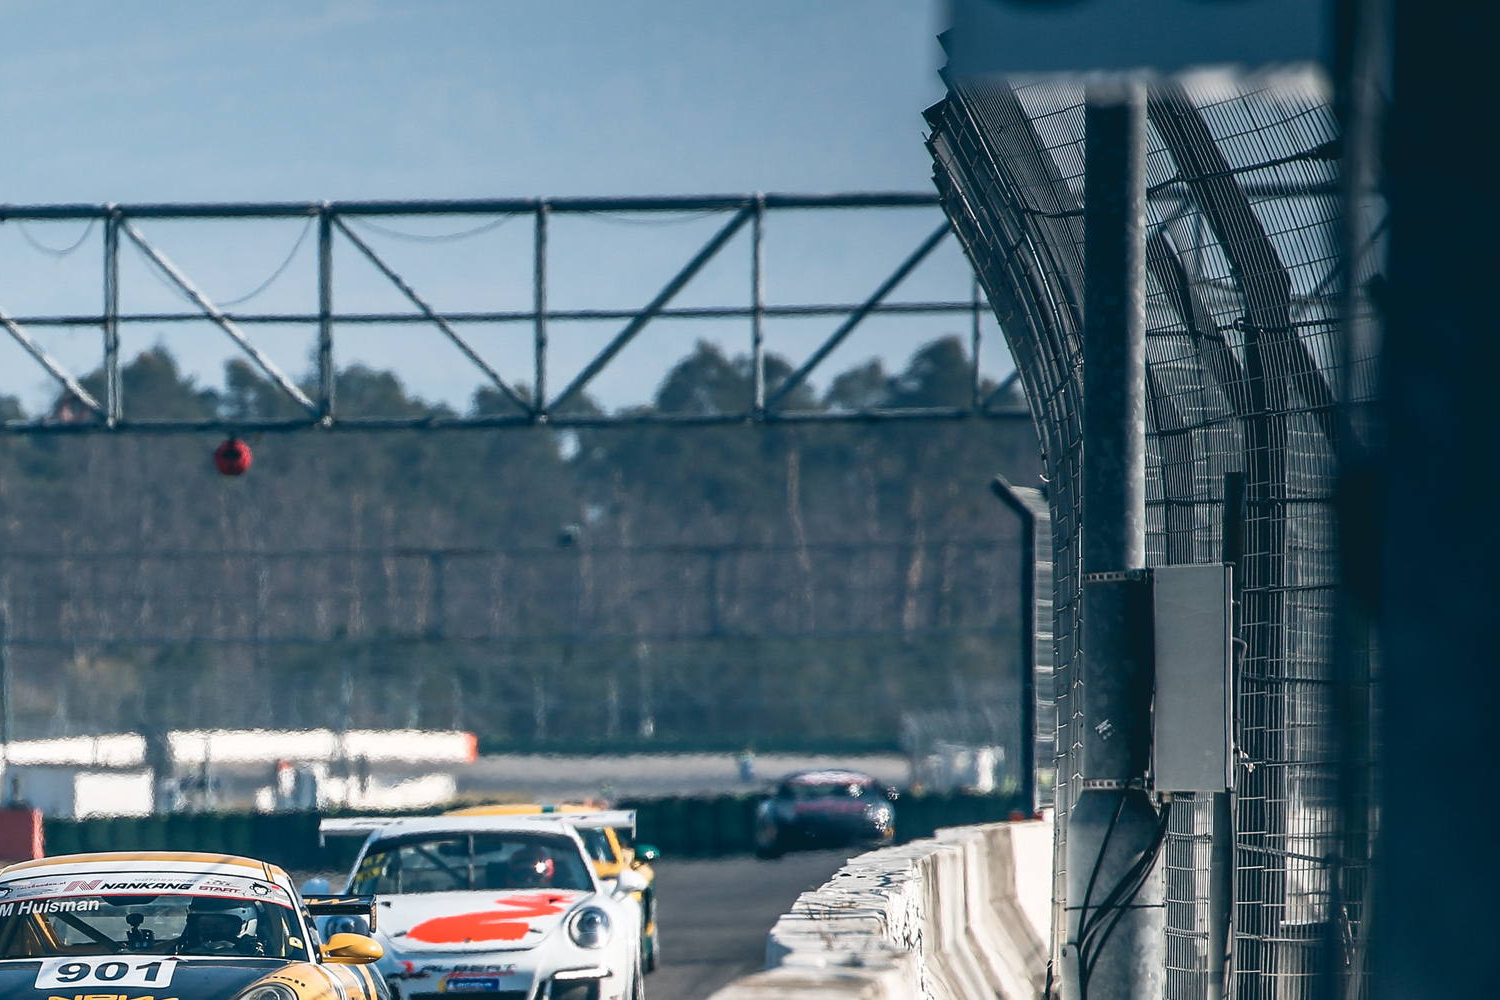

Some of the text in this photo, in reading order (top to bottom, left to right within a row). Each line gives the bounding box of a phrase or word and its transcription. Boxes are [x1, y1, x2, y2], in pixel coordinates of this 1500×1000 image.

[100, 882, 195, 890] NANKANG
[17, 899, 100, 916] Huisman
[55, 961, 163, 983] 901
